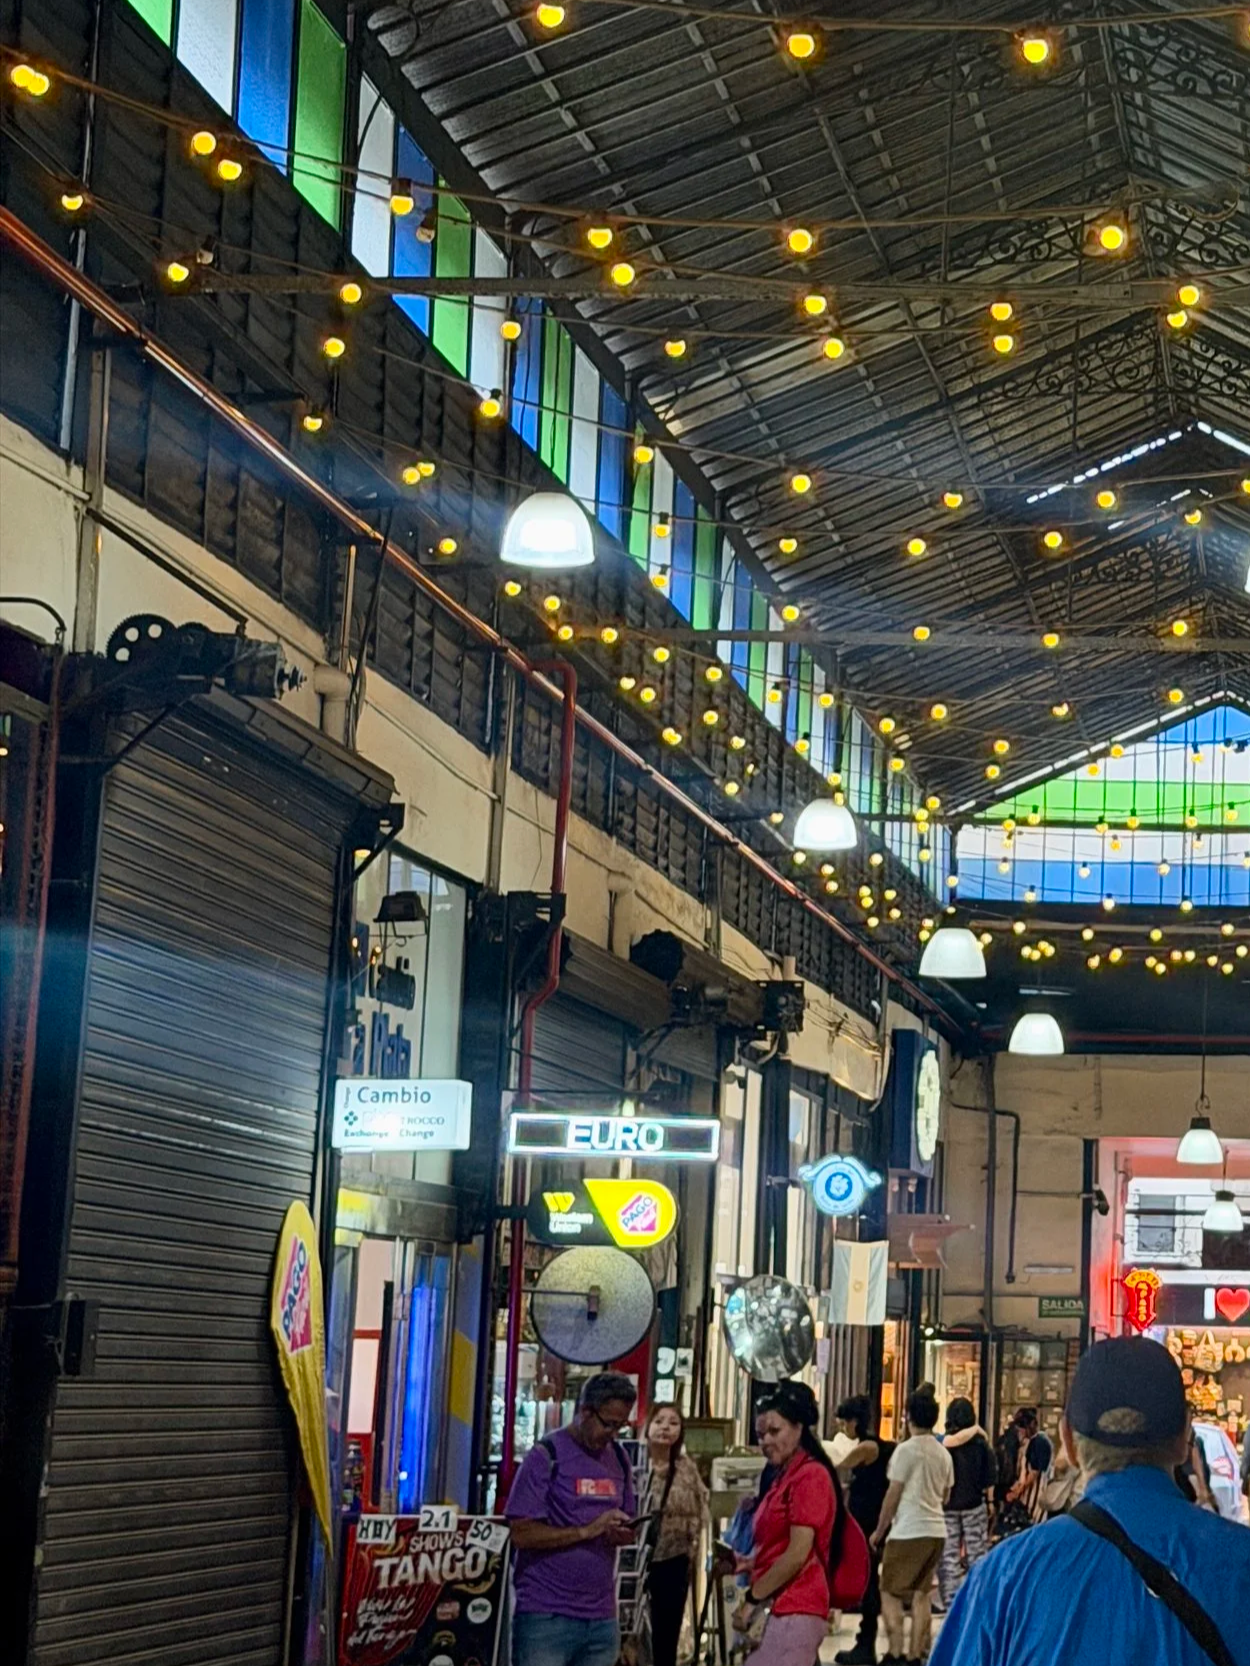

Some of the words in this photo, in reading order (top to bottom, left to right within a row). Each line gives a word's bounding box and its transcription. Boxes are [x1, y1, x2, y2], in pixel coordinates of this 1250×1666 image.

[357, 1086, 432, 1104] Cambio
[399, 1128, 435, 1139] Change
[567, 1120, 665, 1151] EURO
[621, 1196, 654, 1228] PAGO
[281, 1239, 307, 1342] PAGO
[1042, 1299, 1084, 1310] SALIDA
[1204, 1287, 1216, 1320] I
[409, 1530, 465, 1553] SHOWS
[373, 1546, 488, 1590] TANGO
